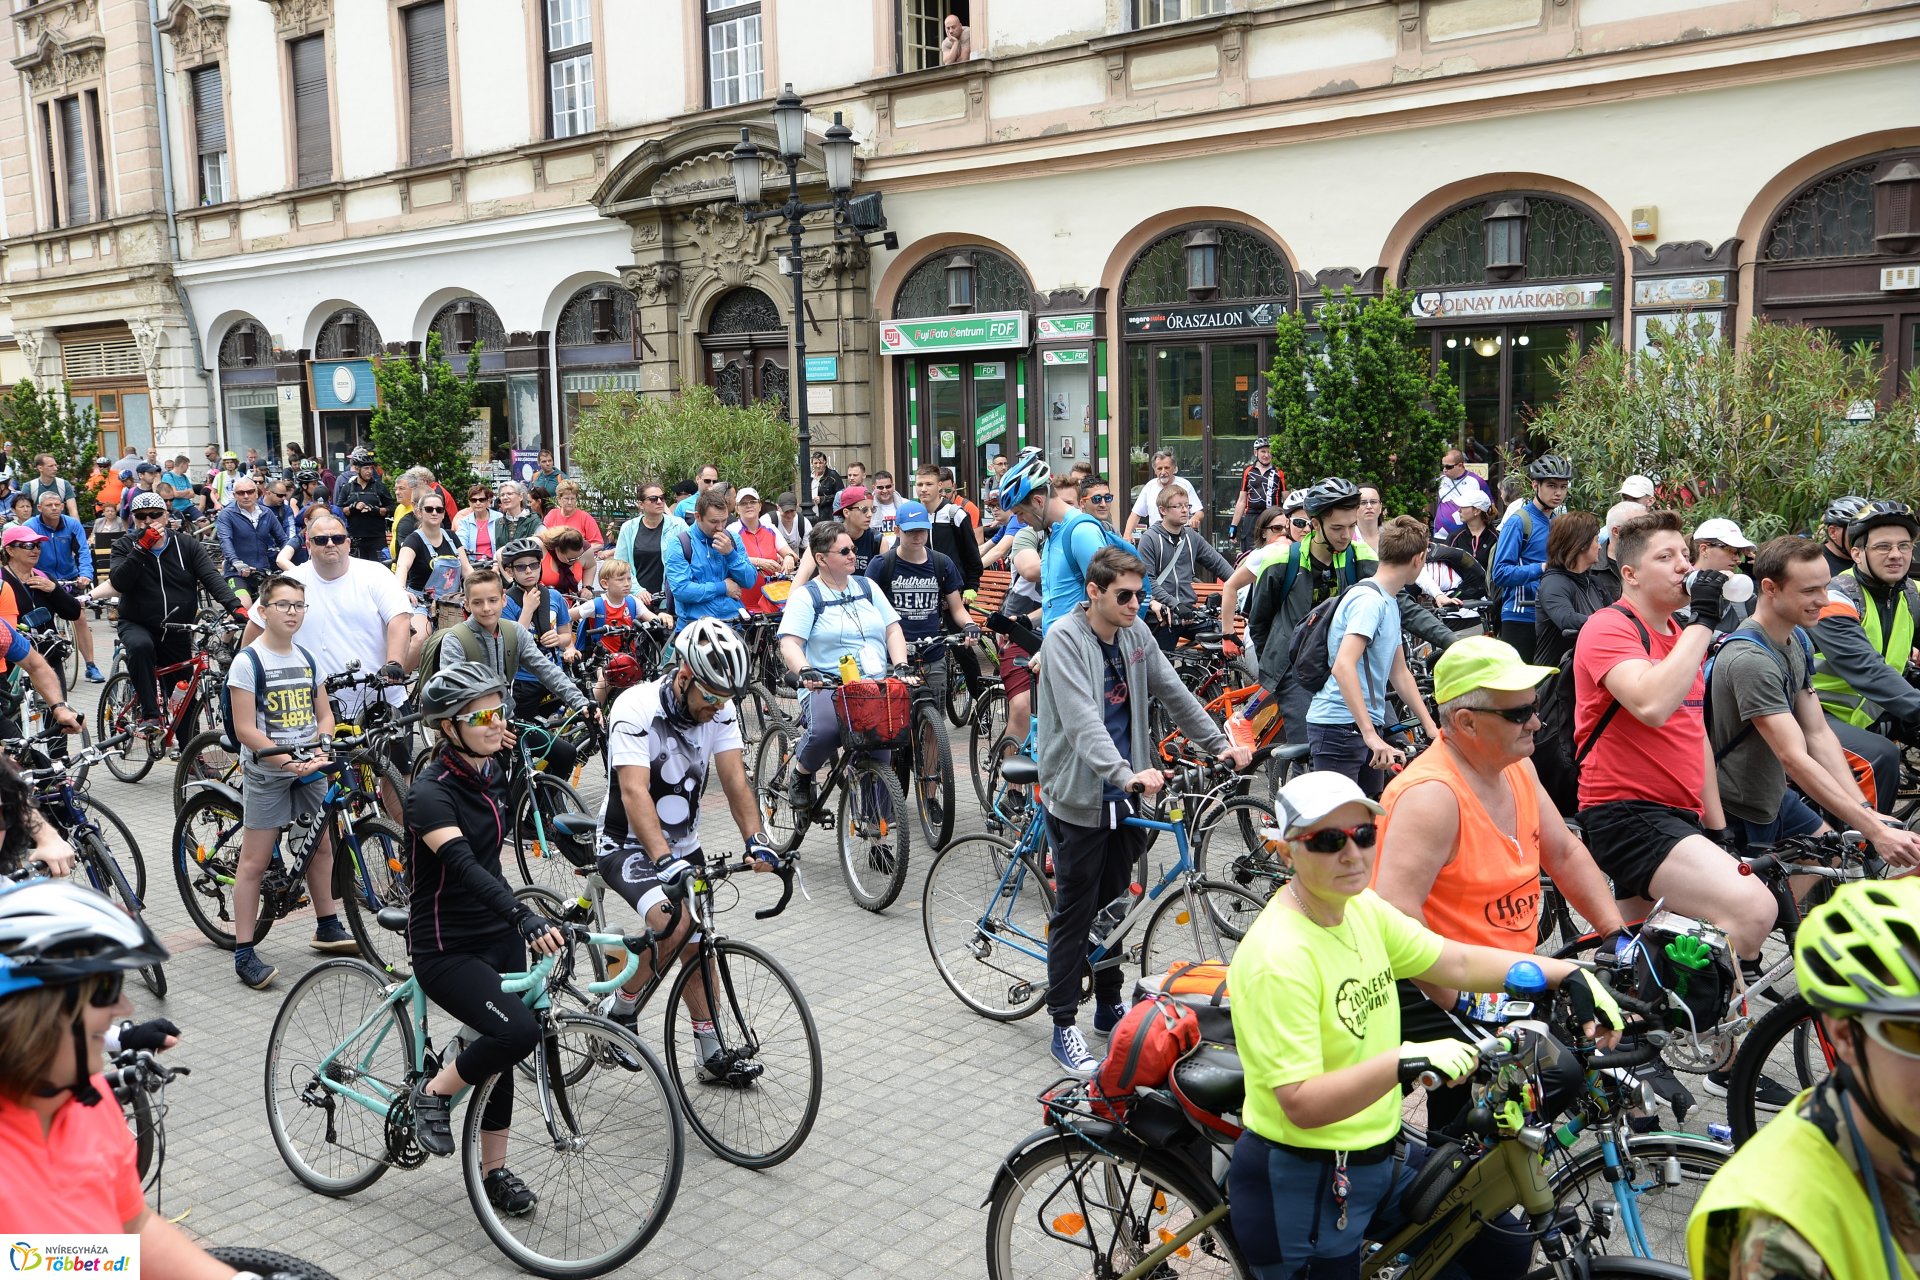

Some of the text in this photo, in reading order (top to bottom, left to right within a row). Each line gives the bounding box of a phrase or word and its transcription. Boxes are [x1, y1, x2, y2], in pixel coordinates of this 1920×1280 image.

[1423, 290, 1599, 314] ZSOLNAY MÁRKABOLT
[1166, 312, 1243, 329] ÓRASZALON
[914, 326, 984, 342] Fuji Foto Centrum
[989, 322, 1016, 337] FDF
